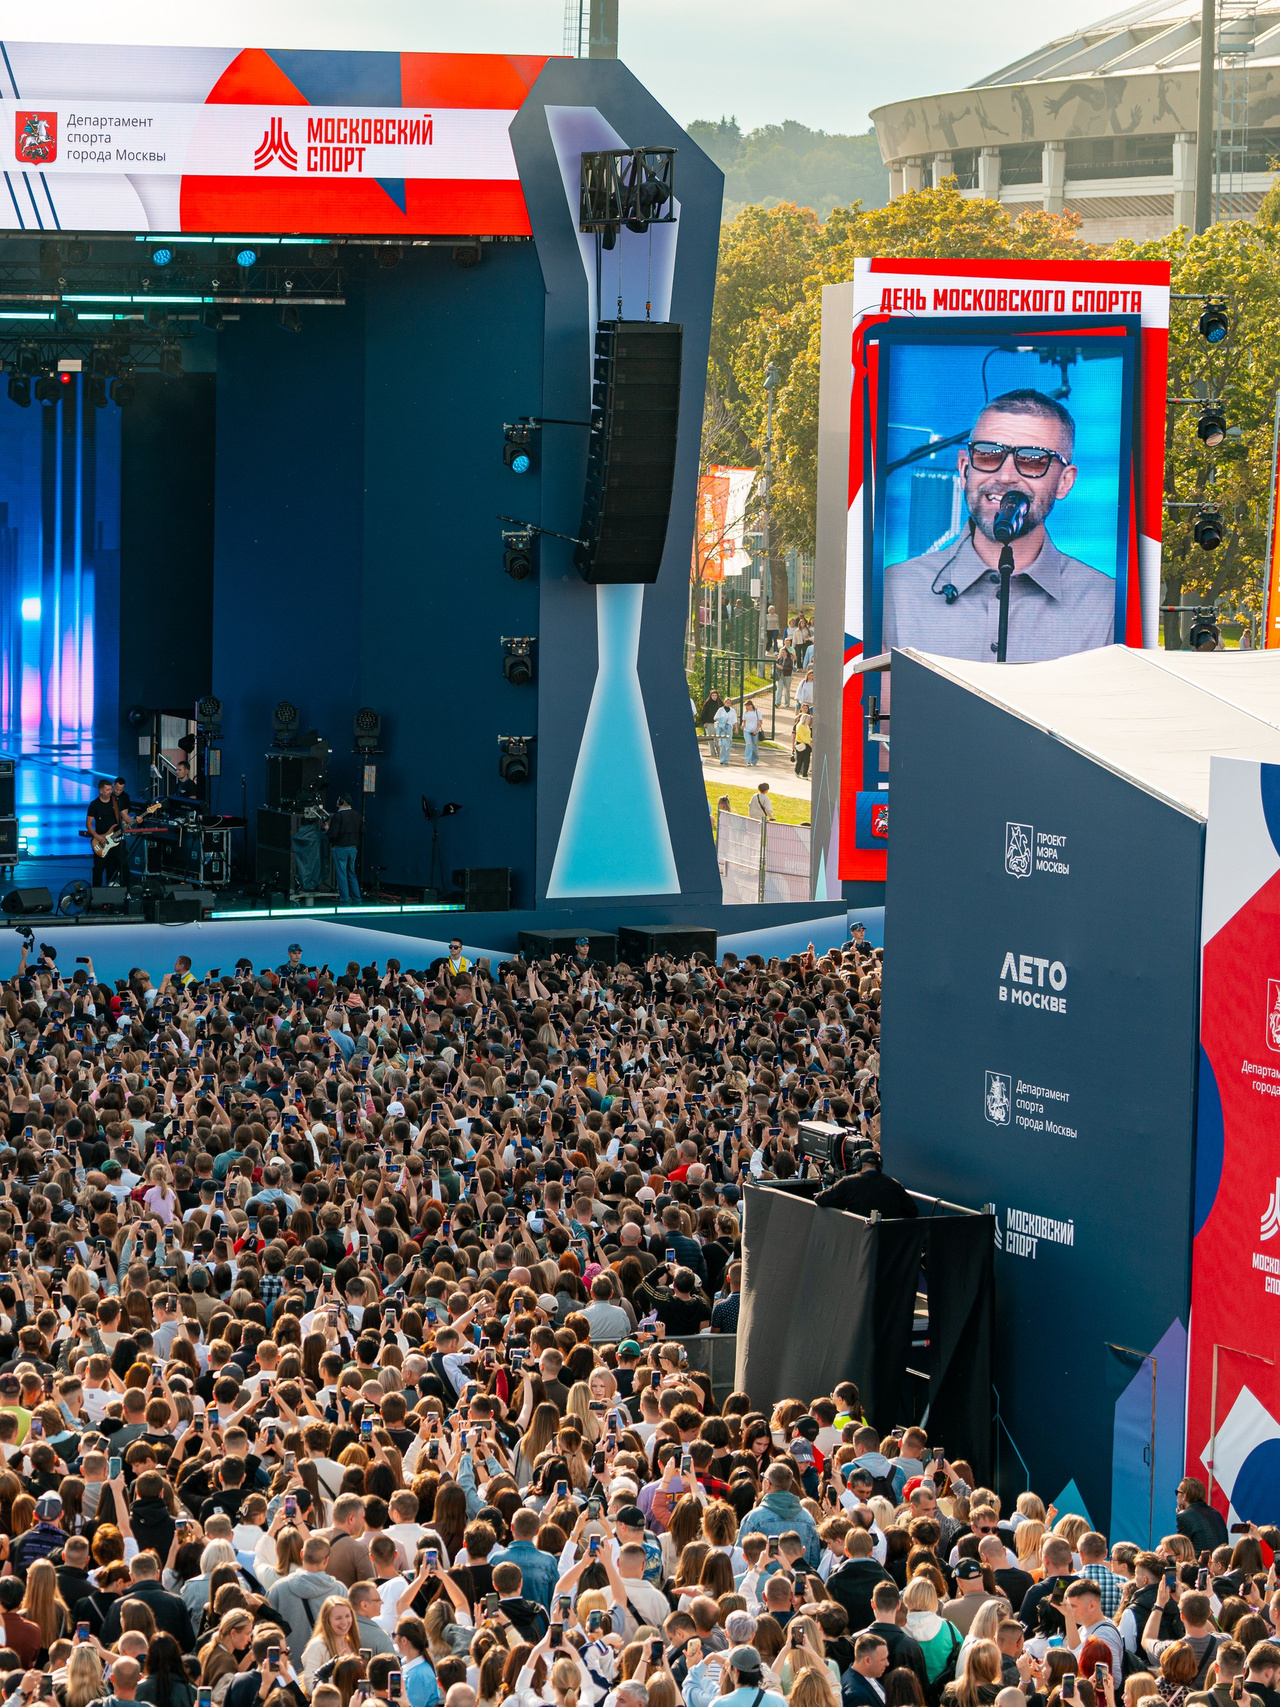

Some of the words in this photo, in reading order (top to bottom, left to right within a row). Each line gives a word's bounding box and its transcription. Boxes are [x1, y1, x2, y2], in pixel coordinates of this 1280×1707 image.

[67, 113, 153, 131] Департамент
[307, 113, 433, 146] МОСКОВСКИЙ
[67, 133, 112, 147] спорта
[67, 149, 113, 164] города
[116, 149, 166, 163] Москвы
[307, 147, 366, 173] СПОРТ
[880, 288, 926, 313] ДЕНЬ
[933, 288, 1065, 313] МОСКОВСКОГО
[1072, 290, 1142, 313] СПОРТА
[1036, 832, 1067, 847] ПРОЕКТ
[1036, 846, 1058, 860] МЭРА
[1036, 859, 1069, 875] МОСКВЫ
[999, 951, 1067, 991] ЛЕТО
[999, 985, 1008, 1002] В
[1011, 988, 1067, 1014] МОСКВЕ
[1016, 1079, 1070, 1103] Департамент
[1016, 1098, 1044, 1115] спорта
[1016, 1115, 1044, 1132] города
[1045, 1119, 1078, 1139] Москвы
[1006, 1207, 1074, 1247] МОСКОВСКИЙ
[1005, 1230, 1038, 1260] СПОРТ
